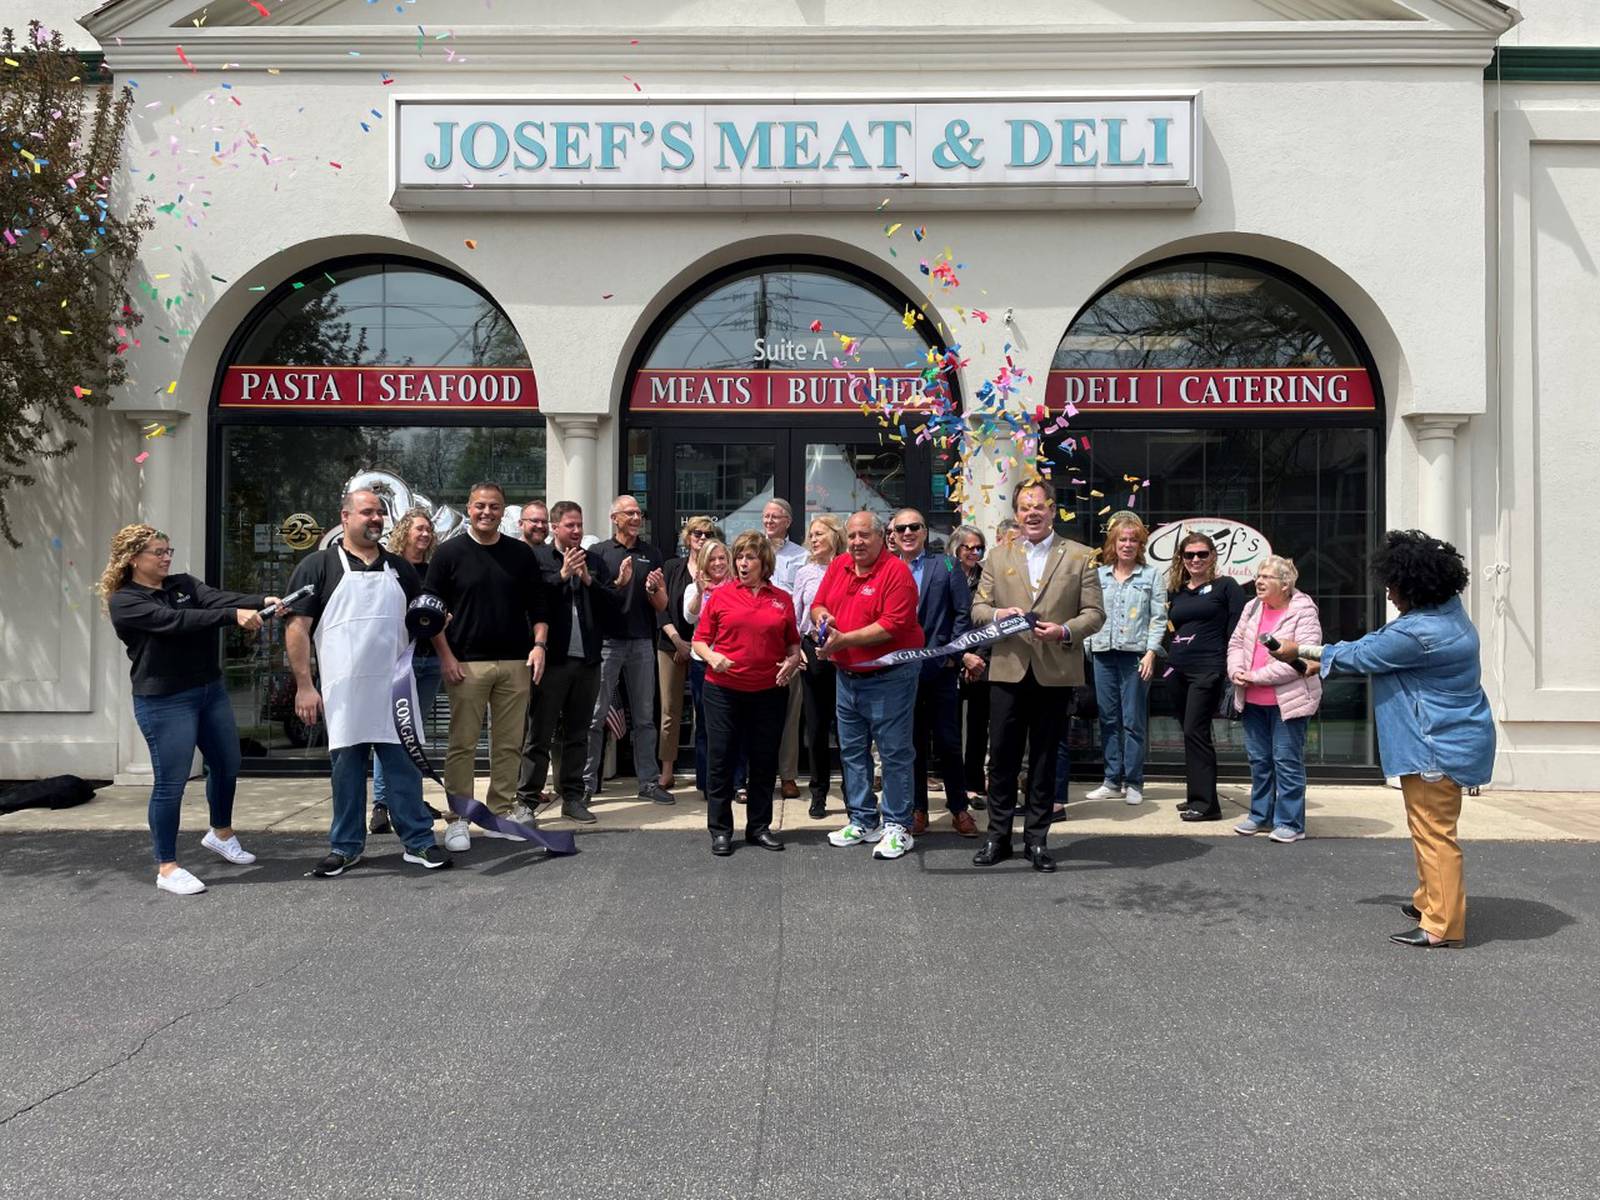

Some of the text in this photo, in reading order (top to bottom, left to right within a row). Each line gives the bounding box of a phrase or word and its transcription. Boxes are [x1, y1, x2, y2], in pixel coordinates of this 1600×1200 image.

[425, 117, 1174, 170] JOSEF'S MEAT & DELI
[753, 338, 828, 361] Suite A
[241, 373, 521, 402] PASTA SEAFOOD
[650, 376, 751, 405] MEATS
[1064, 374, 1349, 404] DELI CATERING
[287, 519, 314, 544] 25
